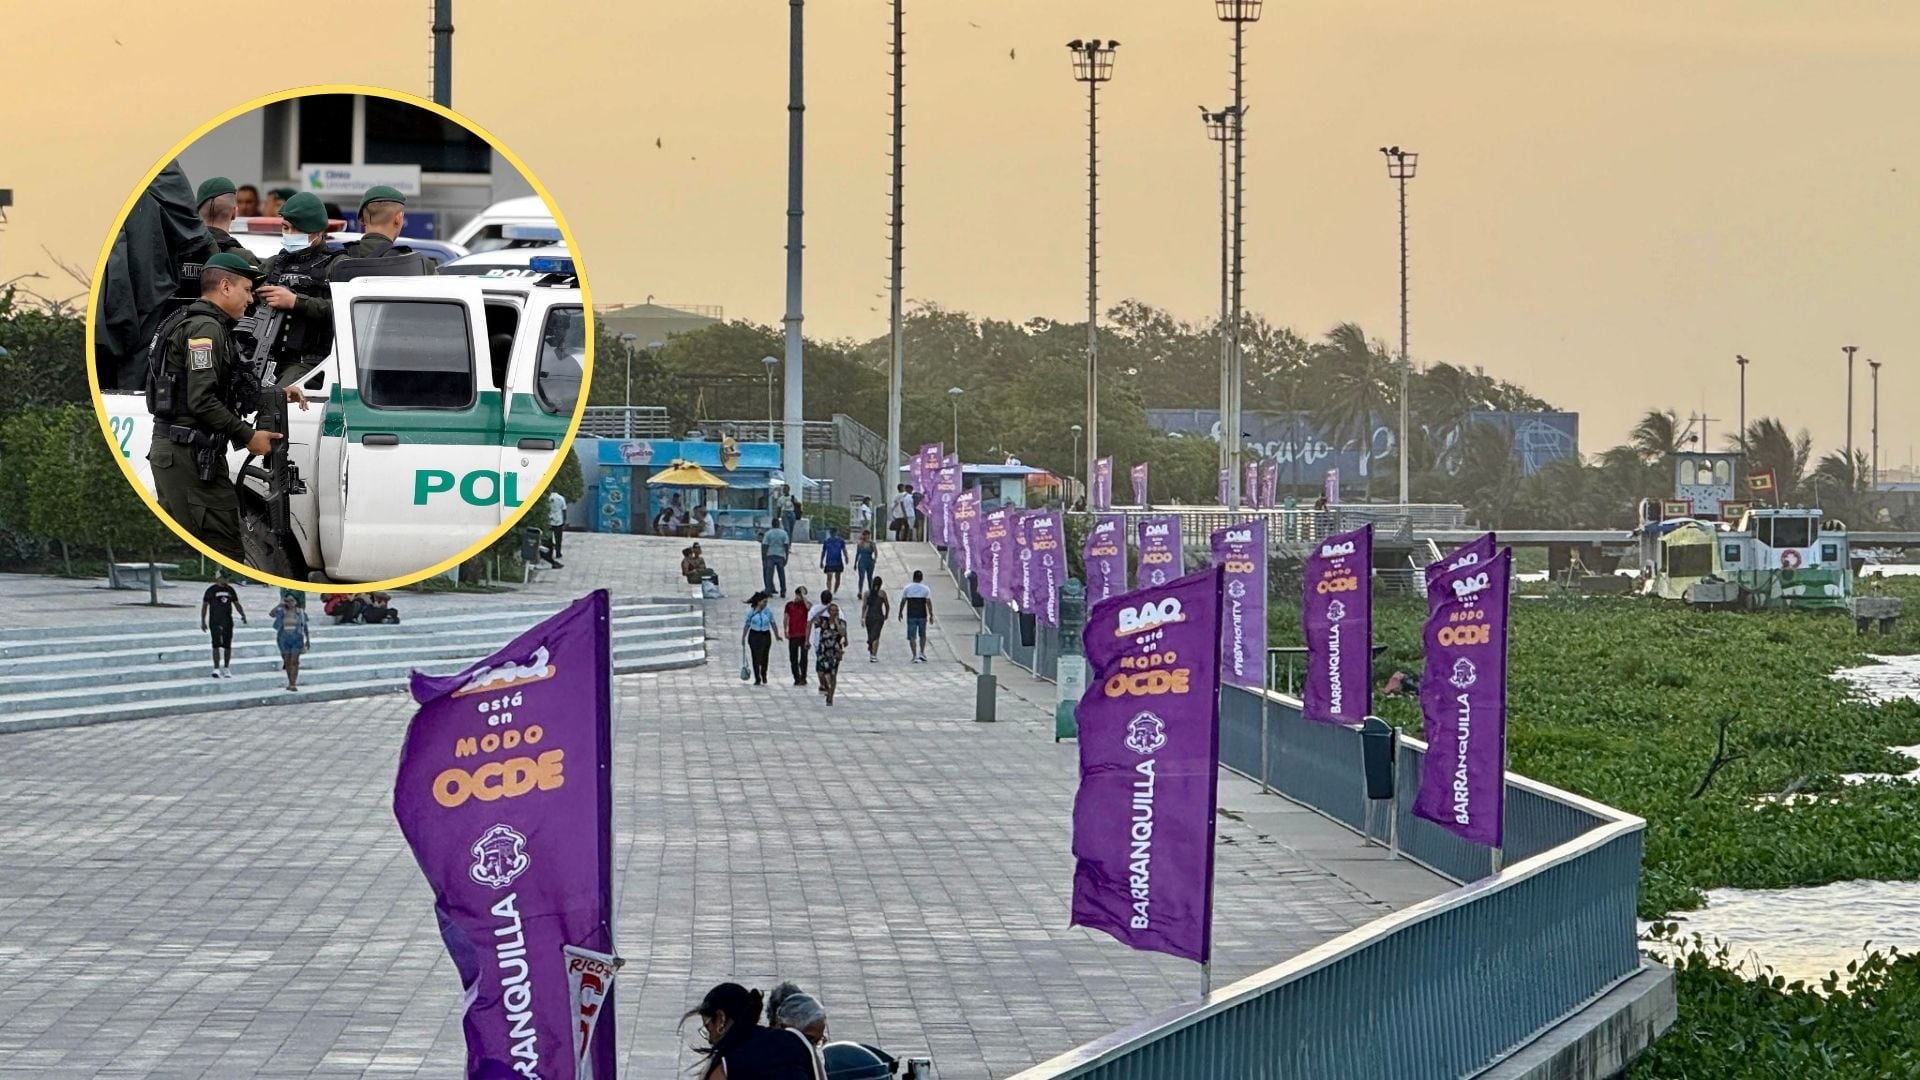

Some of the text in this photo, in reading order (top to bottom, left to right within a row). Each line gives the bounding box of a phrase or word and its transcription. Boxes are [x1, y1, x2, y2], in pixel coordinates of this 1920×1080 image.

[1322, 540, 1356, 558] BAQ
[1316, 577, 1358, 595] OCDE
[1118, 597, 1184, 634] BAQ
[1449, 610, 1484, 622] MODO
[1437, 623, 1491, 647] OCDE
[1120, 651, 1178, 670] MODO
[1330, 624, 1342, 714] BARRANQUILLA
[1104, 669, 1191, 698] OCDE
[478, 691, 523, 714] está
[487, 713, 513, 727] en
[455, 724, 544, 758] MODO
[1453, 693, 1471, 825] BARRANQUILLA
[432, 748, 566, 808] OCDE
[1129, 758, 1156, 929] BARRANQUILLA
[490, 892, 542, 1080] RANQUILLA
